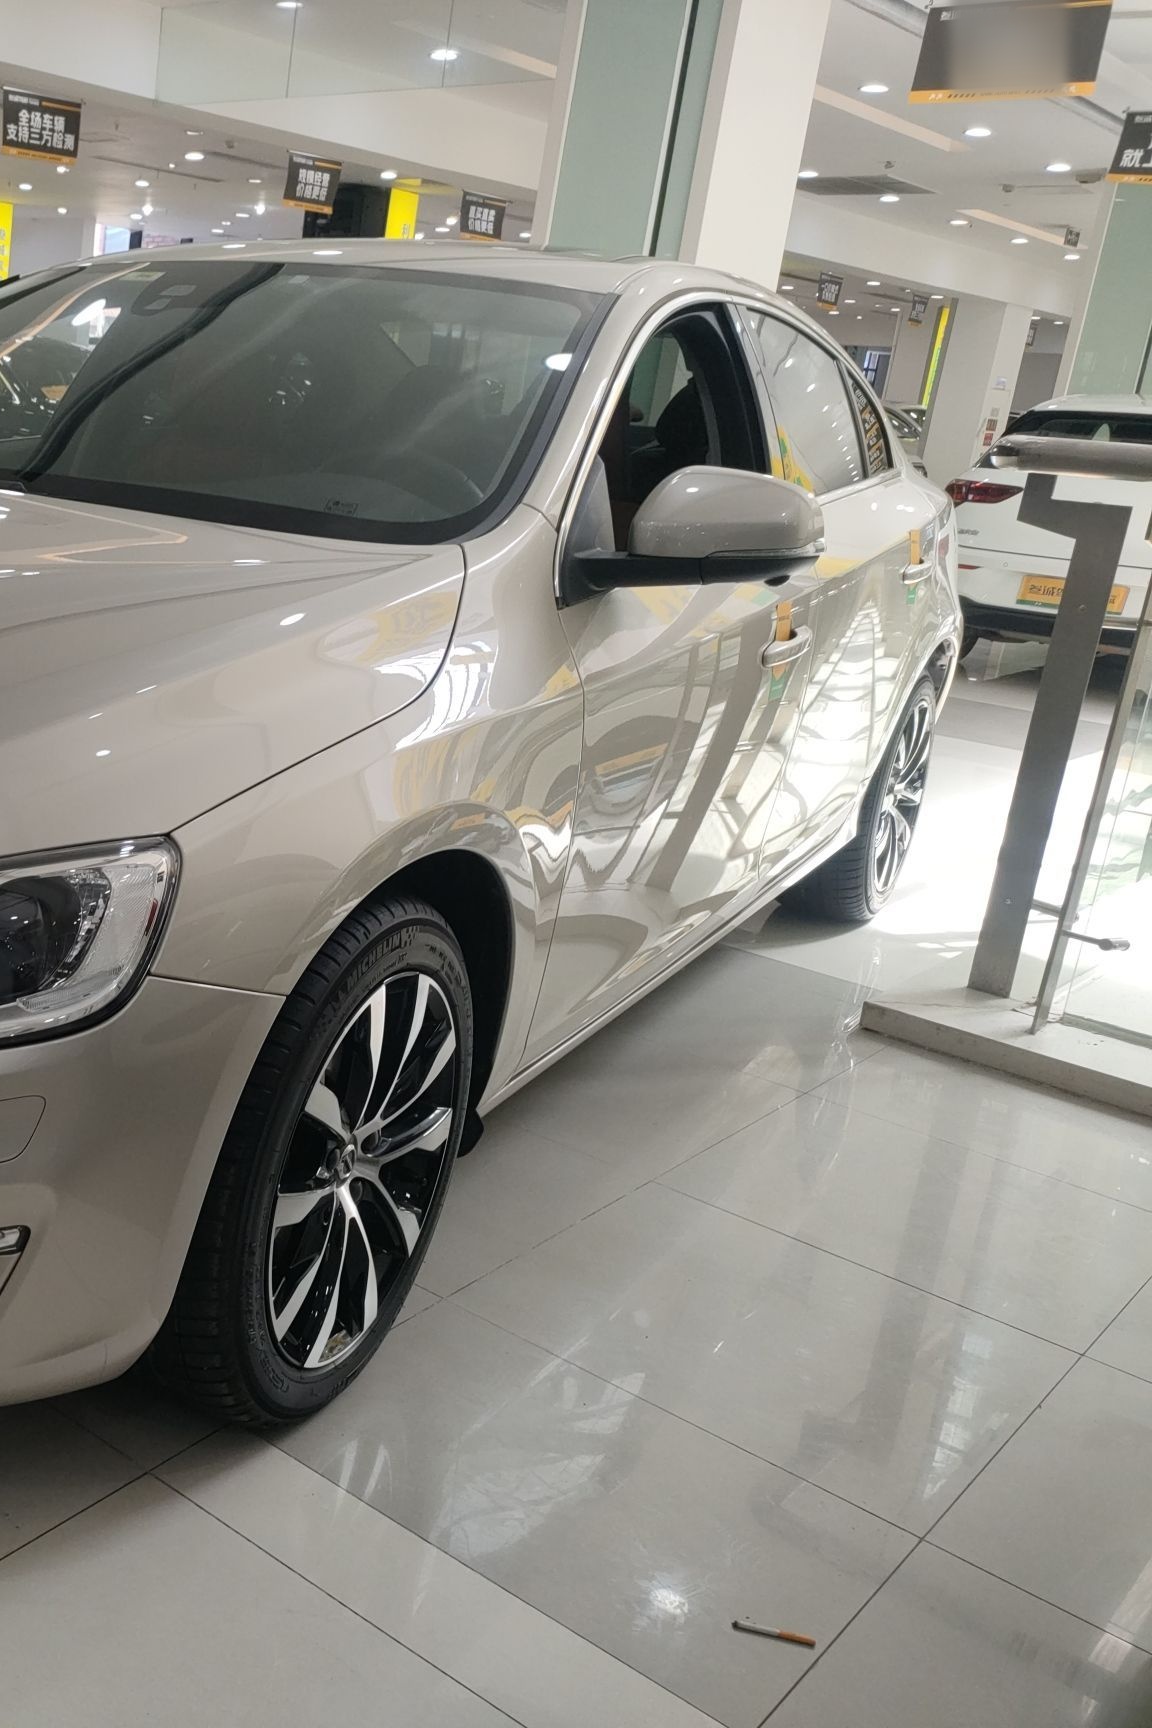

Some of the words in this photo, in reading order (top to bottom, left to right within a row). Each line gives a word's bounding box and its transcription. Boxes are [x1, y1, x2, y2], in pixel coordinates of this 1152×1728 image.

[17, 108, 66, 134] 全场车辆
[5, 123, 76, 152] 支持三方检测
[345, 929, 403, 992] MICHELIN
